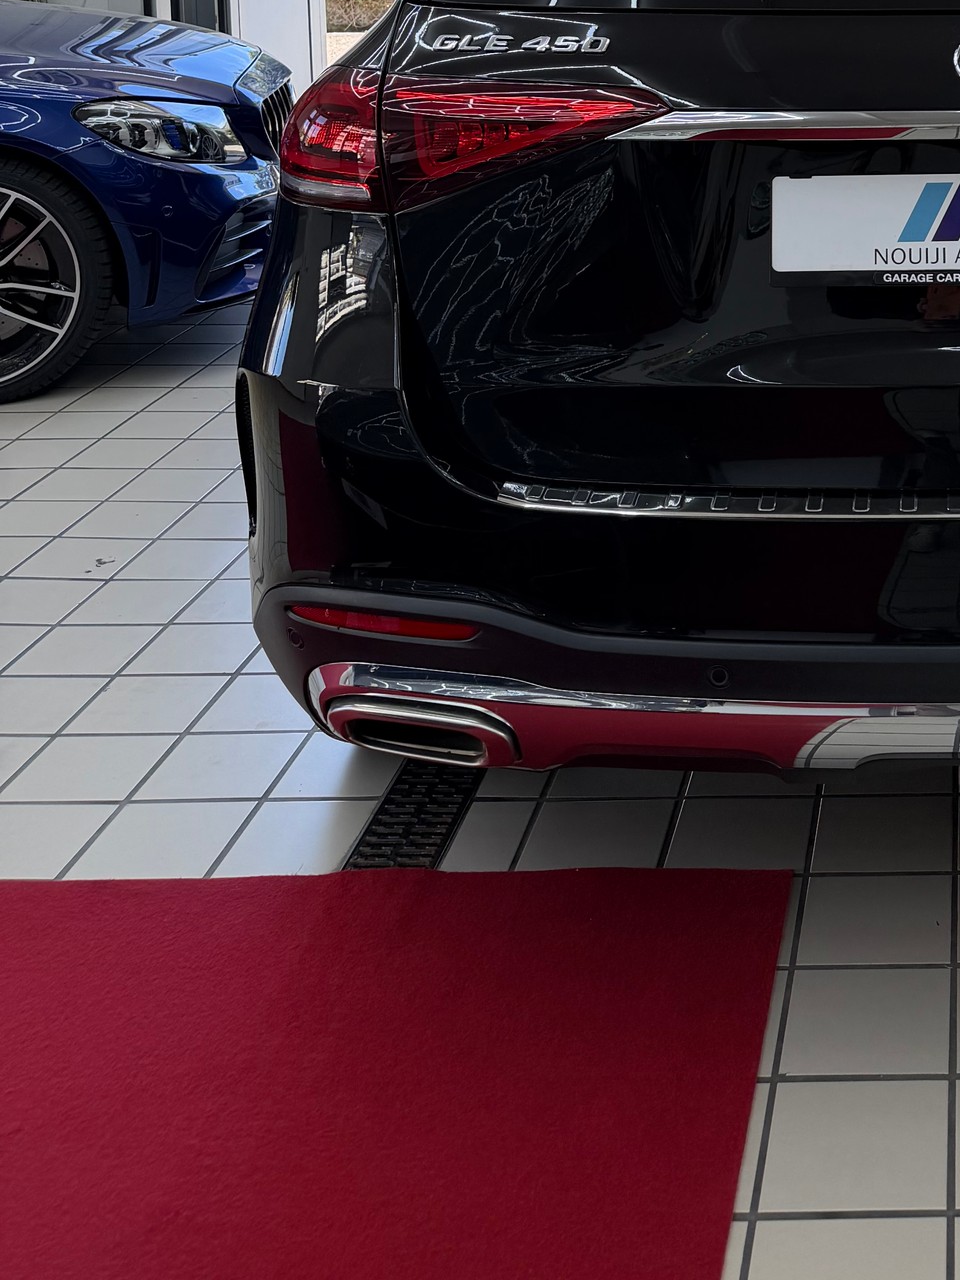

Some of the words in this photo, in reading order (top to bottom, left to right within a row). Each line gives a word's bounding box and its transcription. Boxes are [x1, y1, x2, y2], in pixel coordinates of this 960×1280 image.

[432, 34, 515, 53] GLE
[521, 35, 611, 54] 450
[873, 246, 947, 266] NOUIJI
[882, 272, 934, 283] GARAGE
